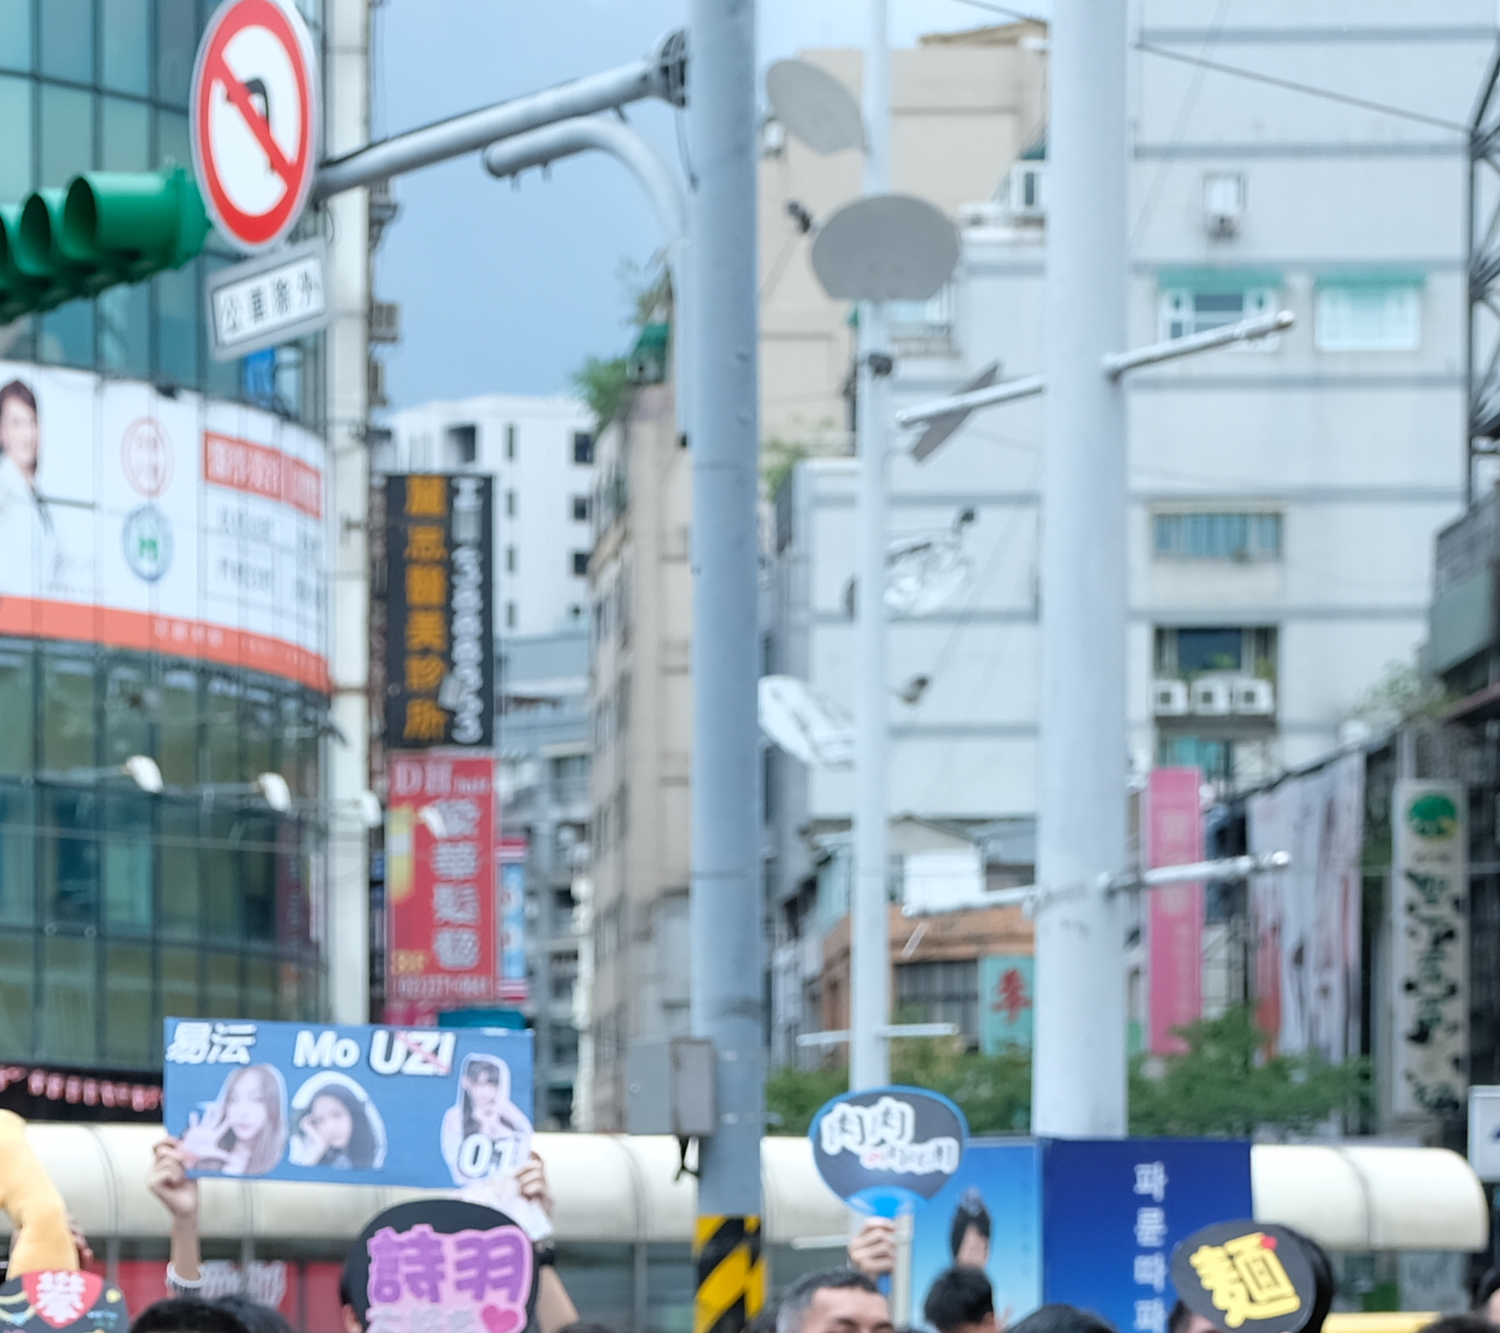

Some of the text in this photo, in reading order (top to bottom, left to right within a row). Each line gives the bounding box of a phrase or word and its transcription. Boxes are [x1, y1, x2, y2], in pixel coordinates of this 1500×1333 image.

[294, 1030, 455, 1077] Mo UZI
[368, 1226, 526, 1302] 詩羽
